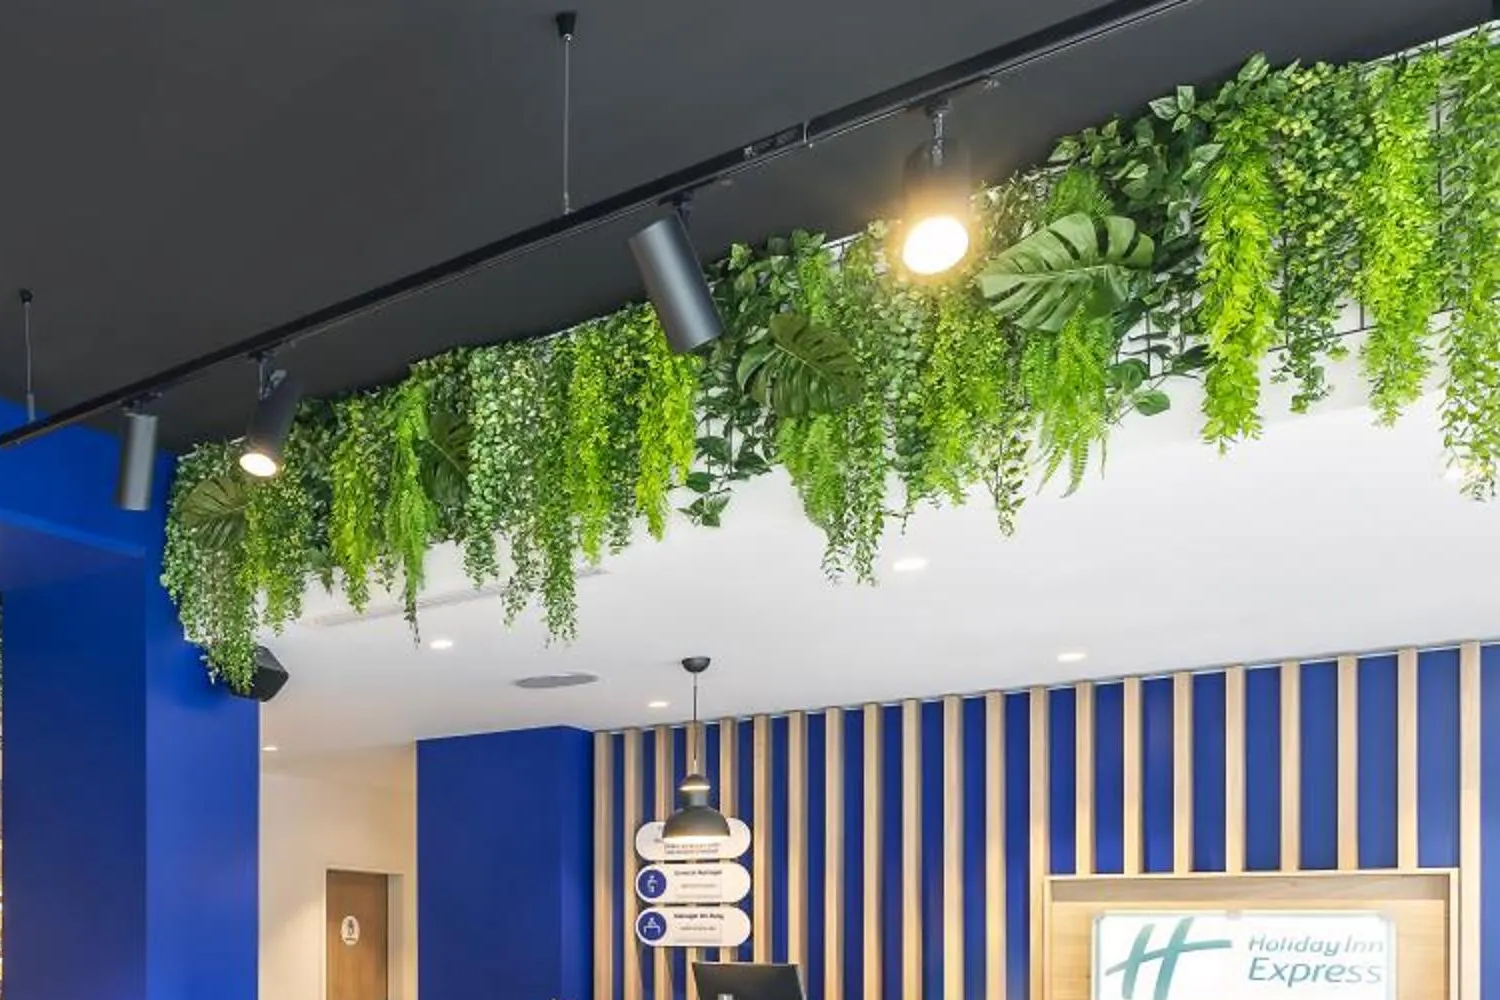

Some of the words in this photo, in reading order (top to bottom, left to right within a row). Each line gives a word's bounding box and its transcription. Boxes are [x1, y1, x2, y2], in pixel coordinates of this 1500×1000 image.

[1248, 934, 1342, 957] Holiday
[1345, 934, 1384, 953] Inn
[1248, 956, 1384, 988] Express
